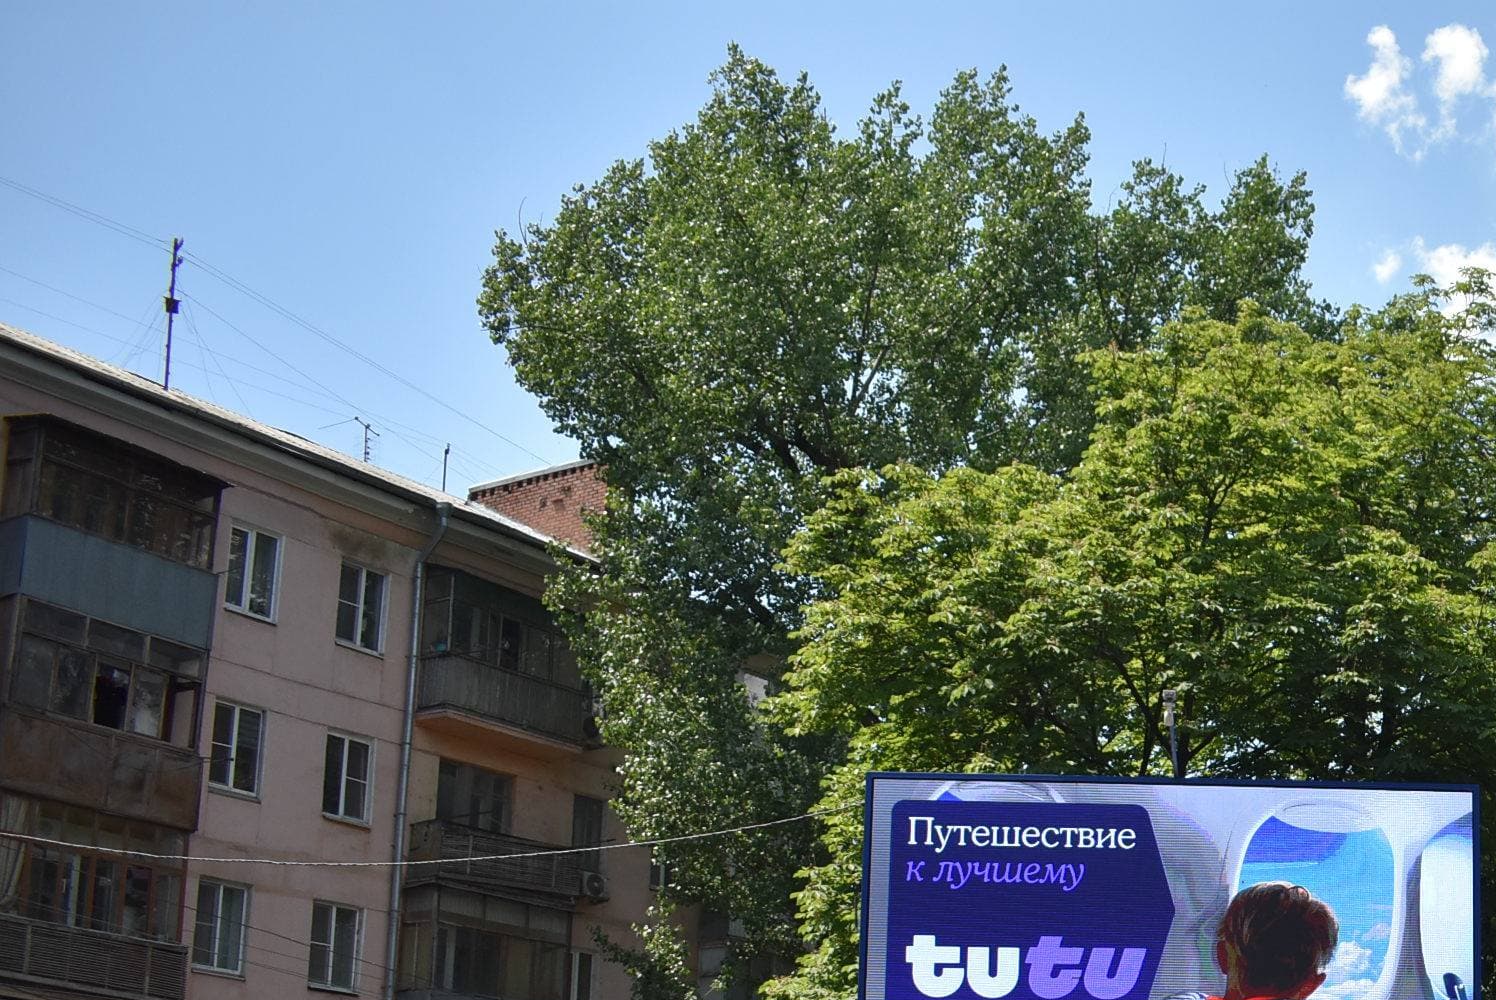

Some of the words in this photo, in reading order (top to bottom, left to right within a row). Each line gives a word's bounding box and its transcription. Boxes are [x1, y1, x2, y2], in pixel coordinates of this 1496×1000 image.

[907, 816, 1137, 853] Путешествие
[906, 860, 926, 882] к
[932, 860, 1086, 891] лучшему
[905, 934, 1147, 1000] tutu
